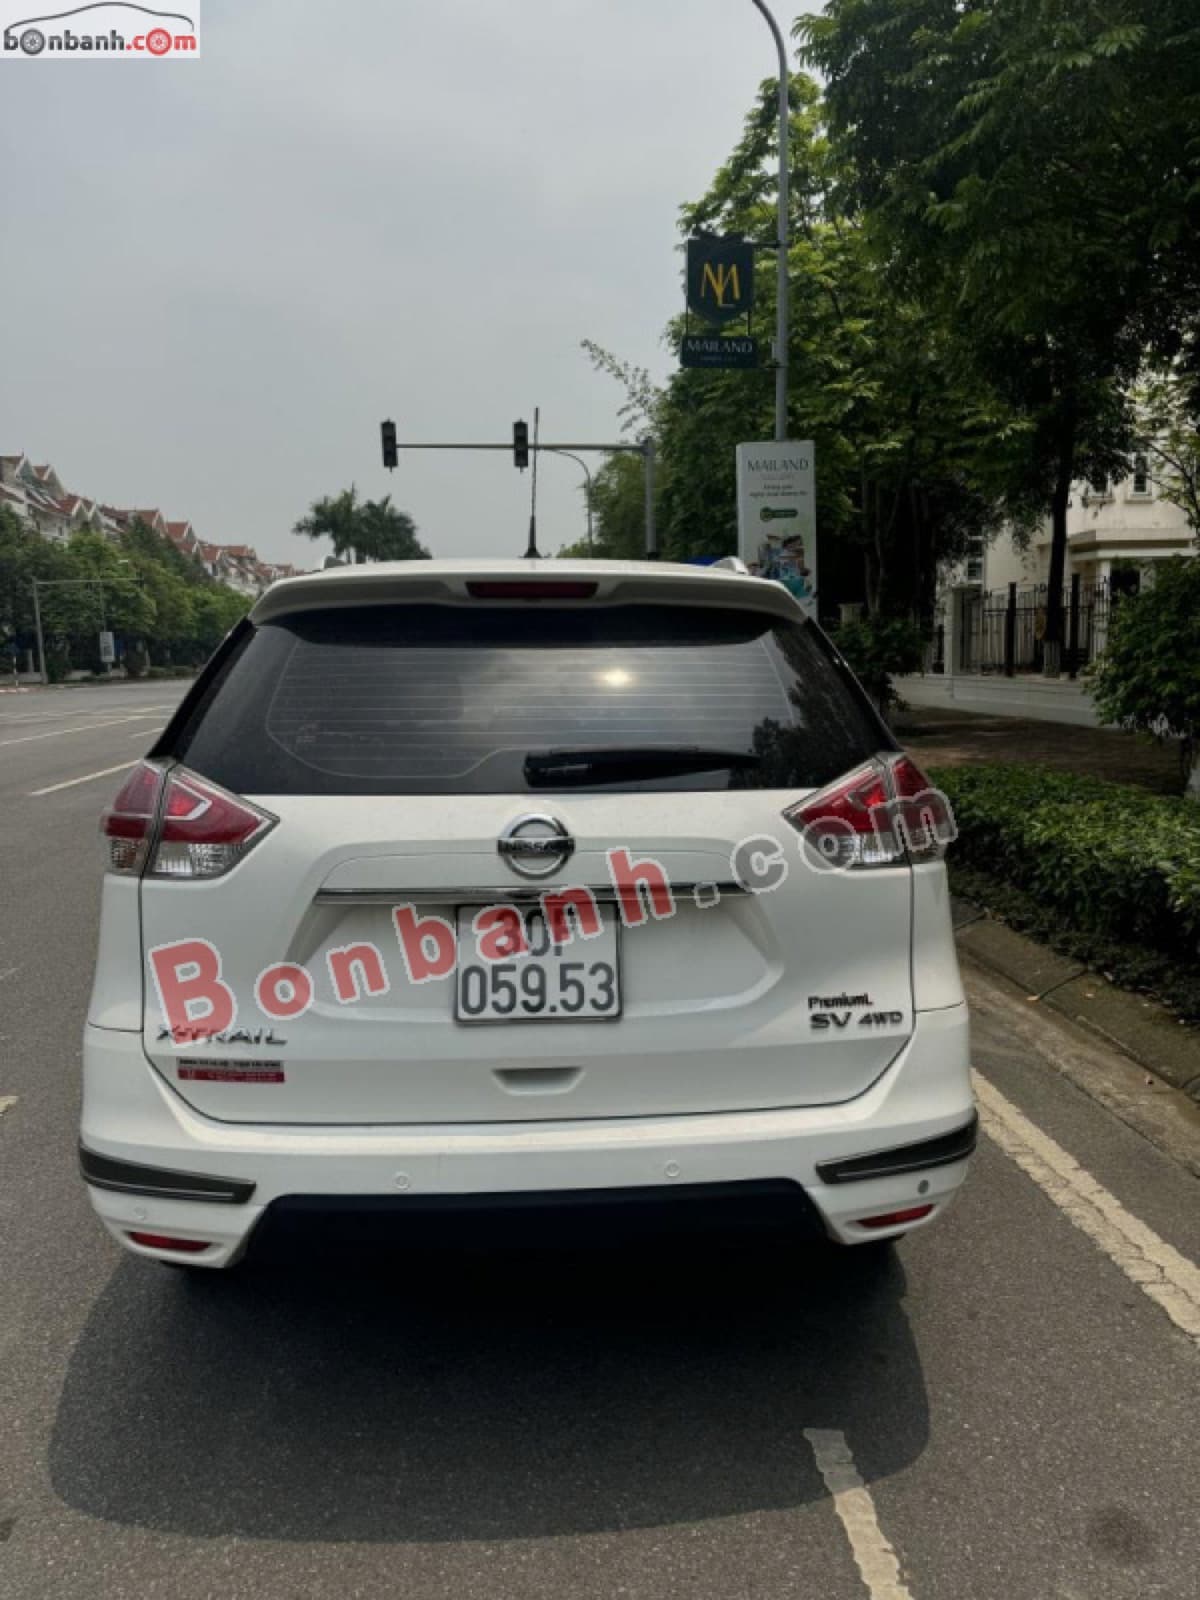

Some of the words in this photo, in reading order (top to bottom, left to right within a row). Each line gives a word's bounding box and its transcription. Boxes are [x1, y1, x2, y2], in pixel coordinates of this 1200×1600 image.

[747, 458, 809, 472] MAILAND
[461, 961, 616, 1016] 059.53
[810, 1011, 852, 1029] SV
[858, 1010, 904, 1027] 4WD
